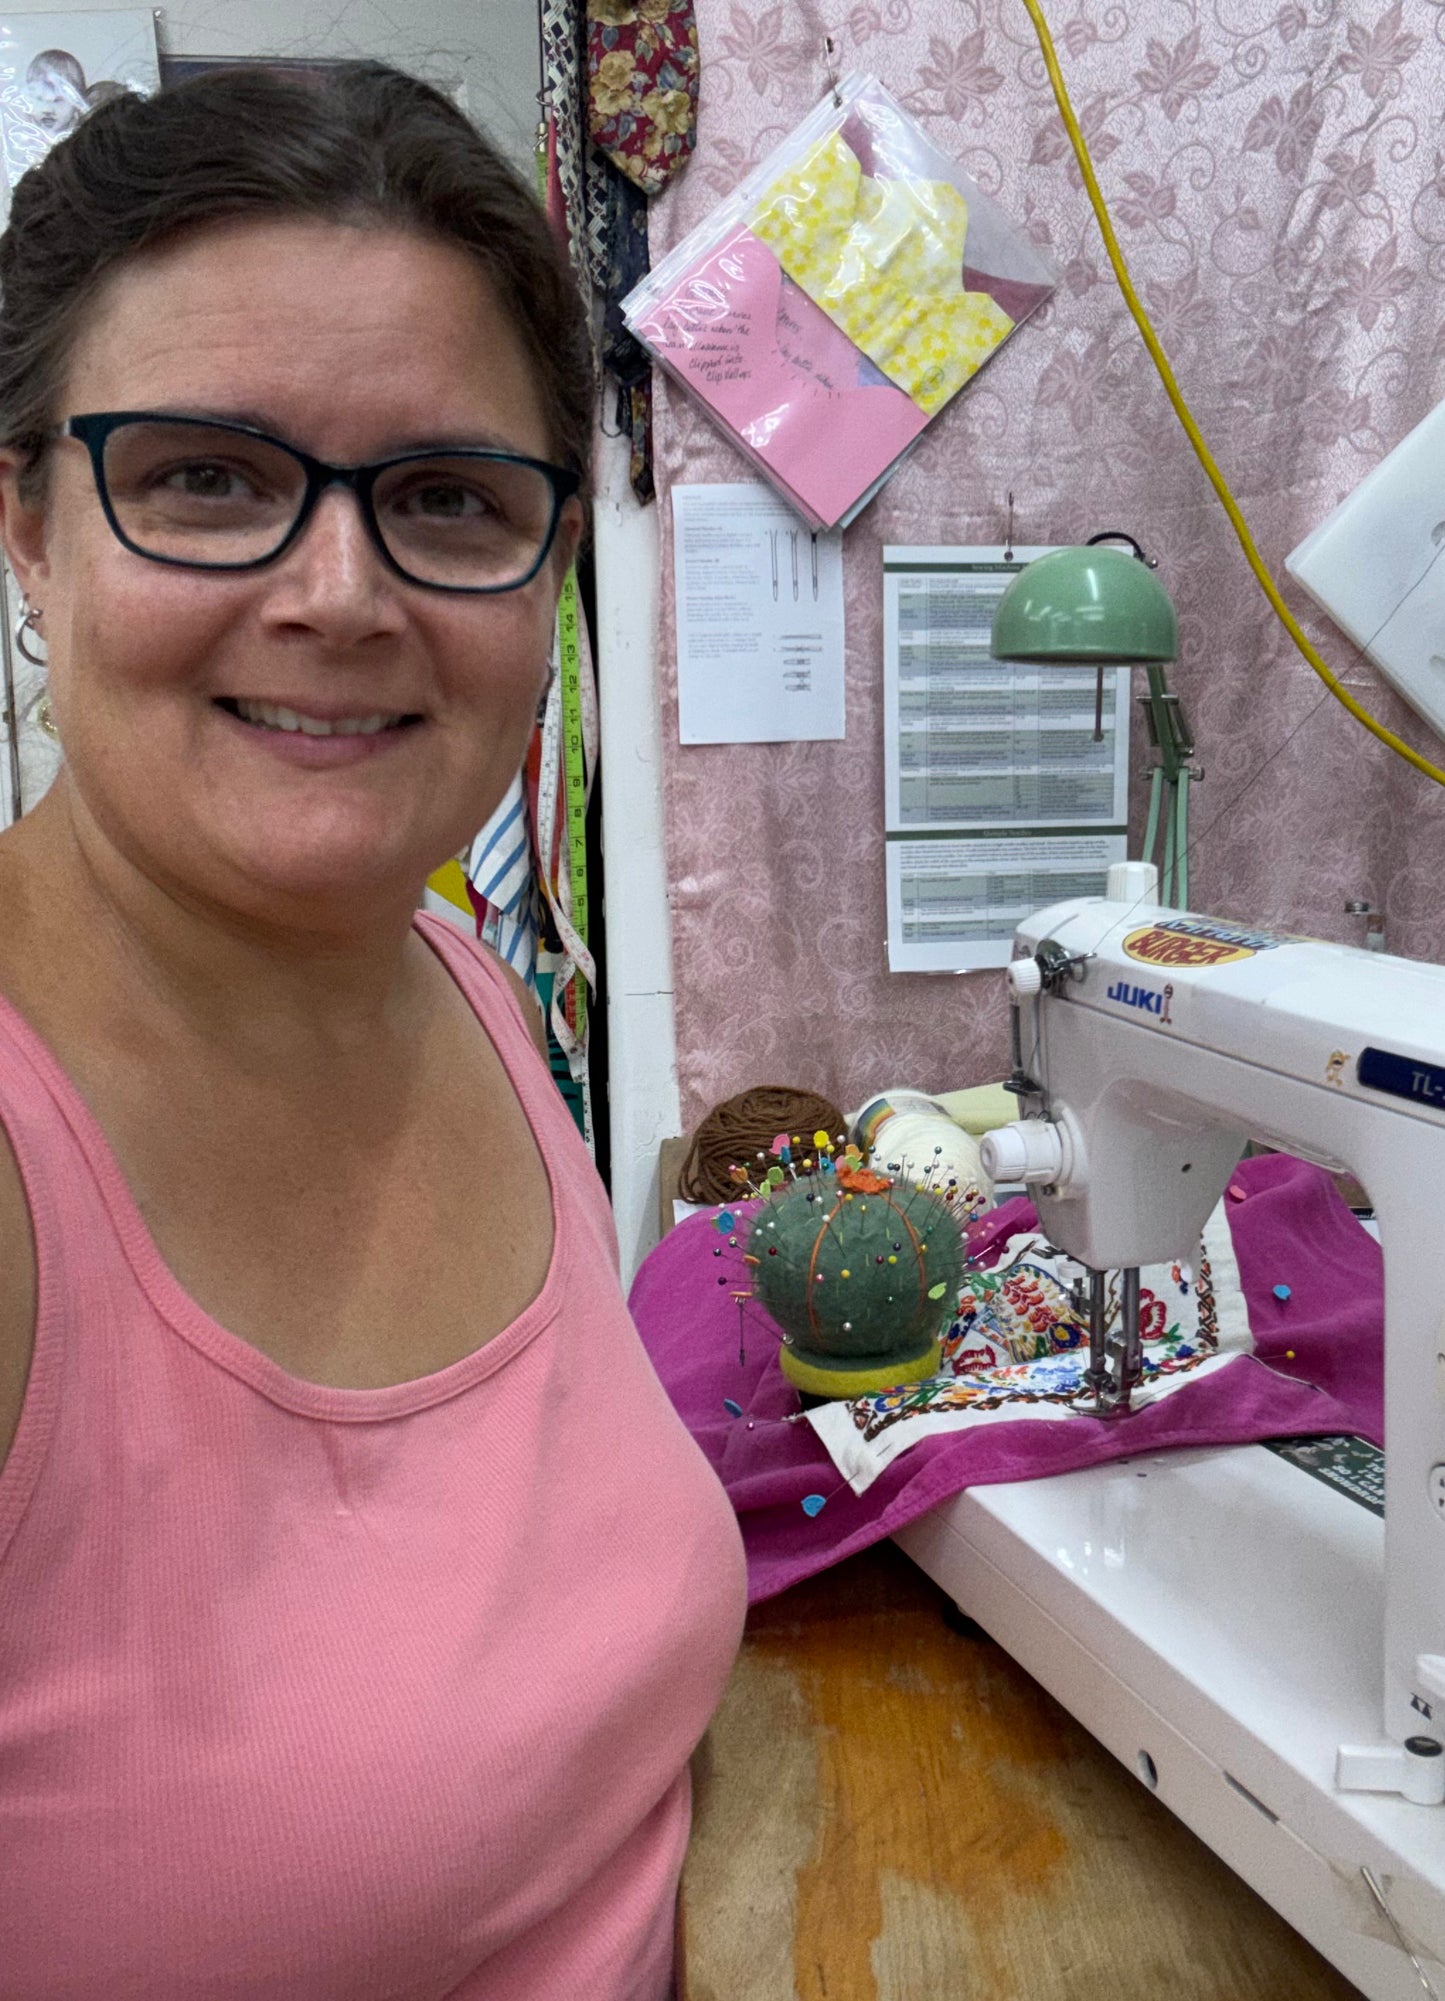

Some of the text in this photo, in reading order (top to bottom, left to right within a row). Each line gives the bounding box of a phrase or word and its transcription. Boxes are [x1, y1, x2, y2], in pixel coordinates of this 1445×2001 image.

[566, 613, 575, 632] 14
[567, 644, 576, 664] 13
[569, 675, 578, 694] 12
[569, 708, 578, 725] 11
[570, 735, 579, 754] 10
[1127, 930, 1239, 965] BURGER
[1106, 982, 1163, 1015] JUKI
[1411, 1071, 1445, 1100] TL-
